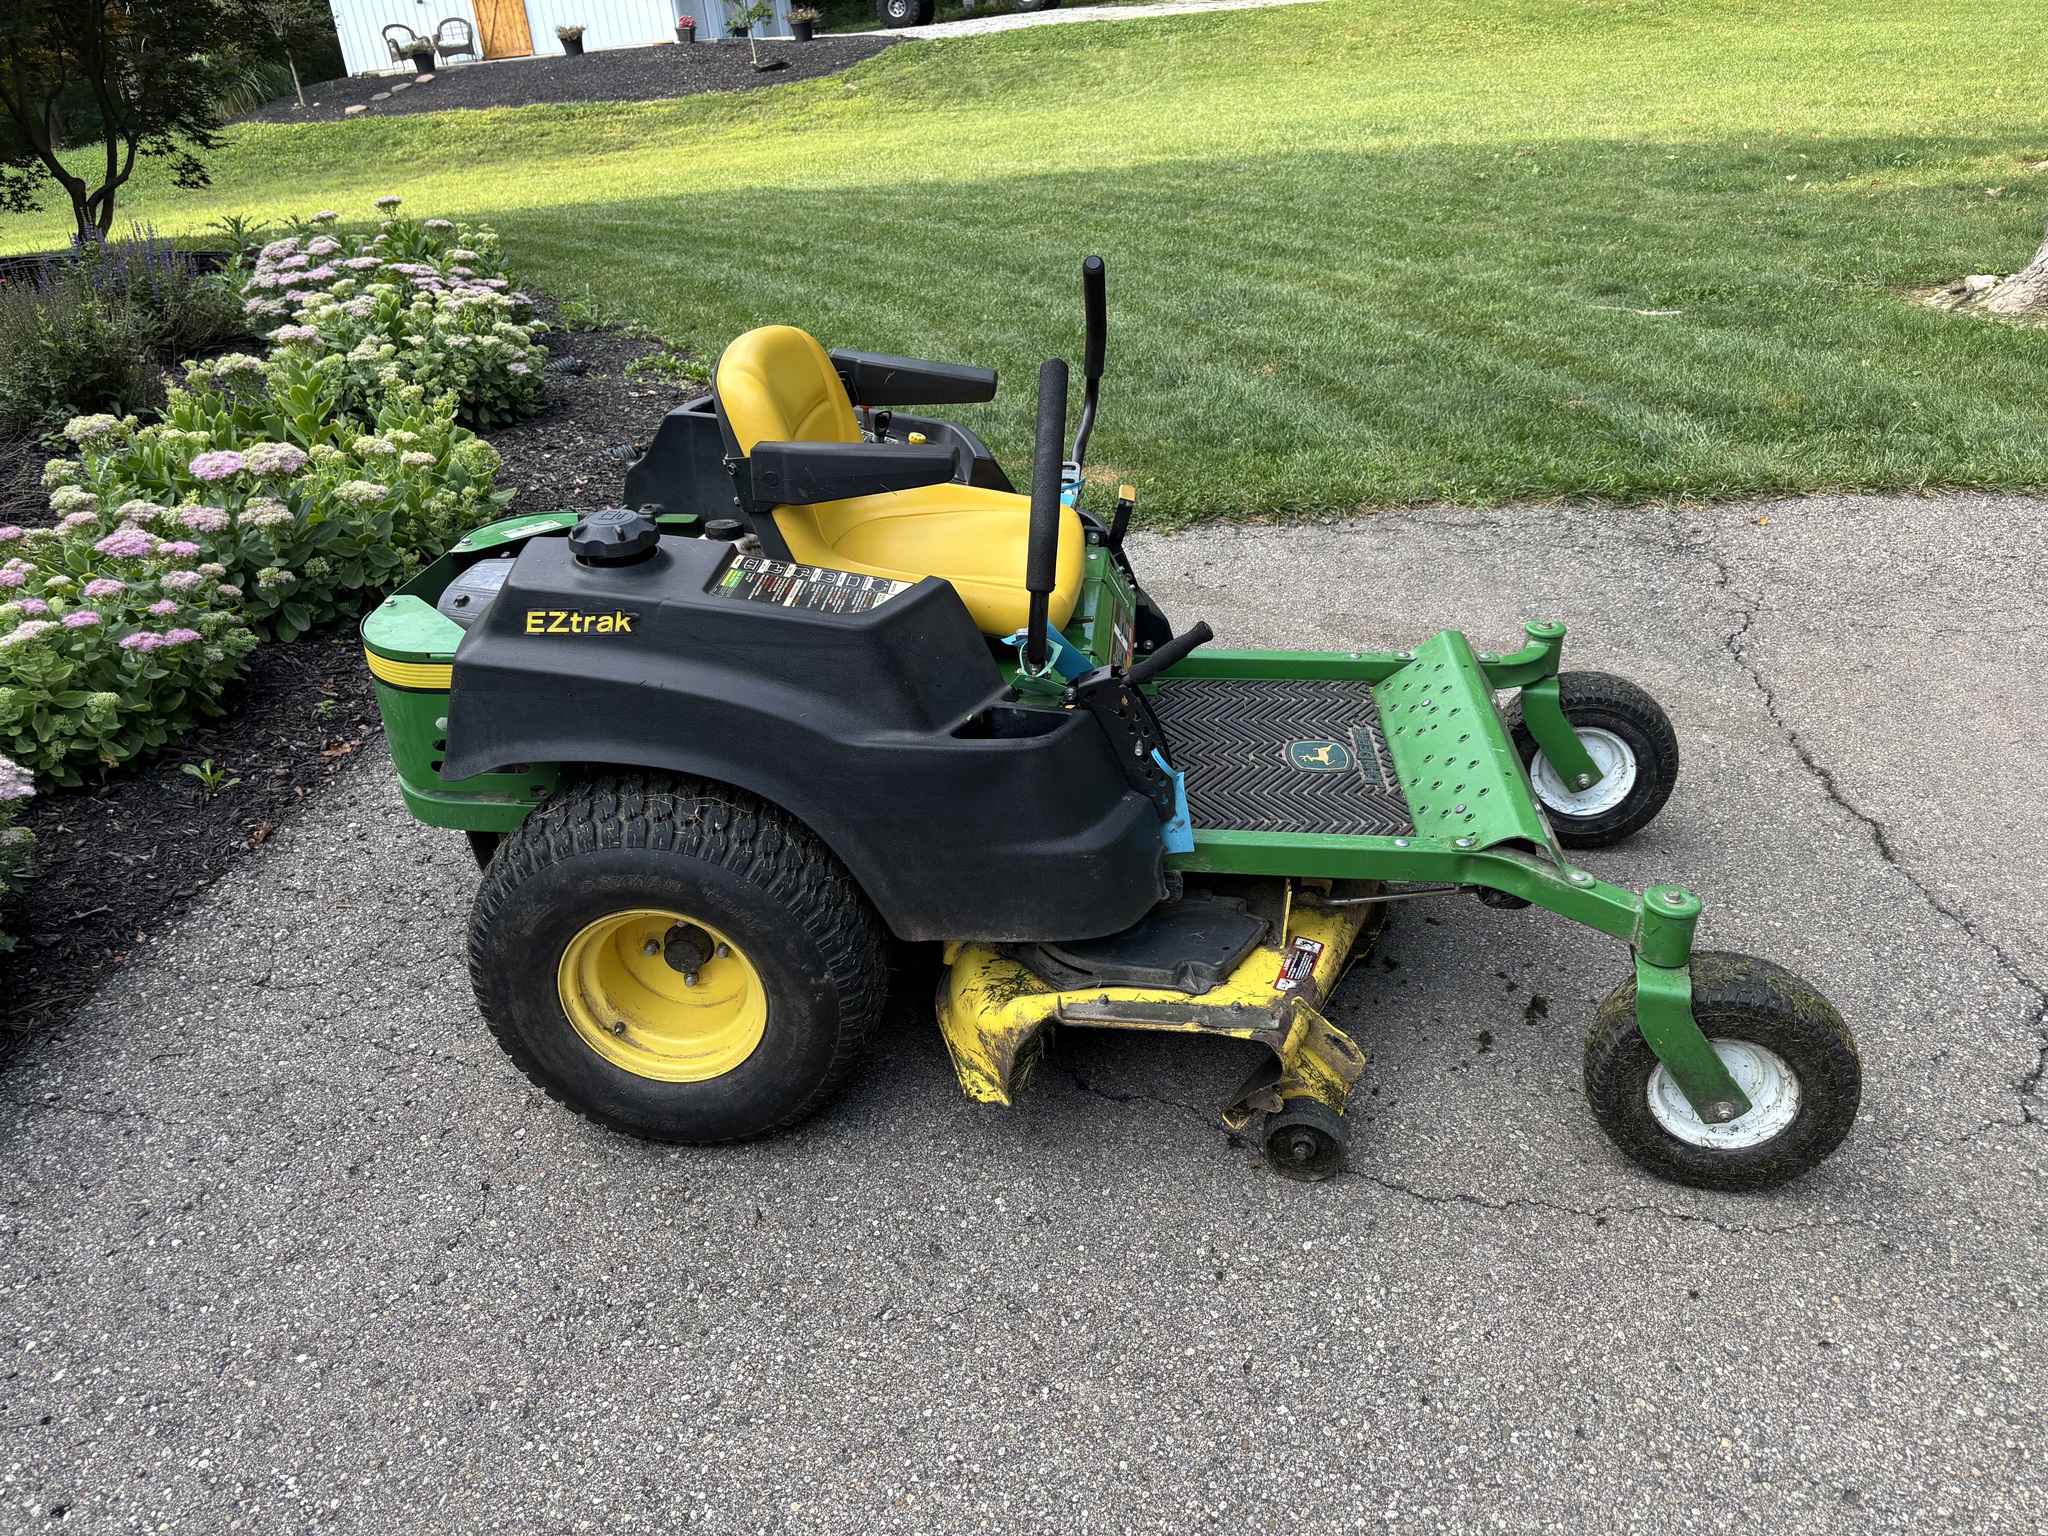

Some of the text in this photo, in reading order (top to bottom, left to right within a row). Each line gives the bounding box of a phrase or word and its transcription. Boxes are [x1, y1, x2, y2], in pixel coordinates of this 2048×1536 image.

[526, 611, 632, 633] EZtrak
[1353, 728, 1386, 788] JOHN DEERE
[579, 874, 771, 933] CAYMAN TURF
